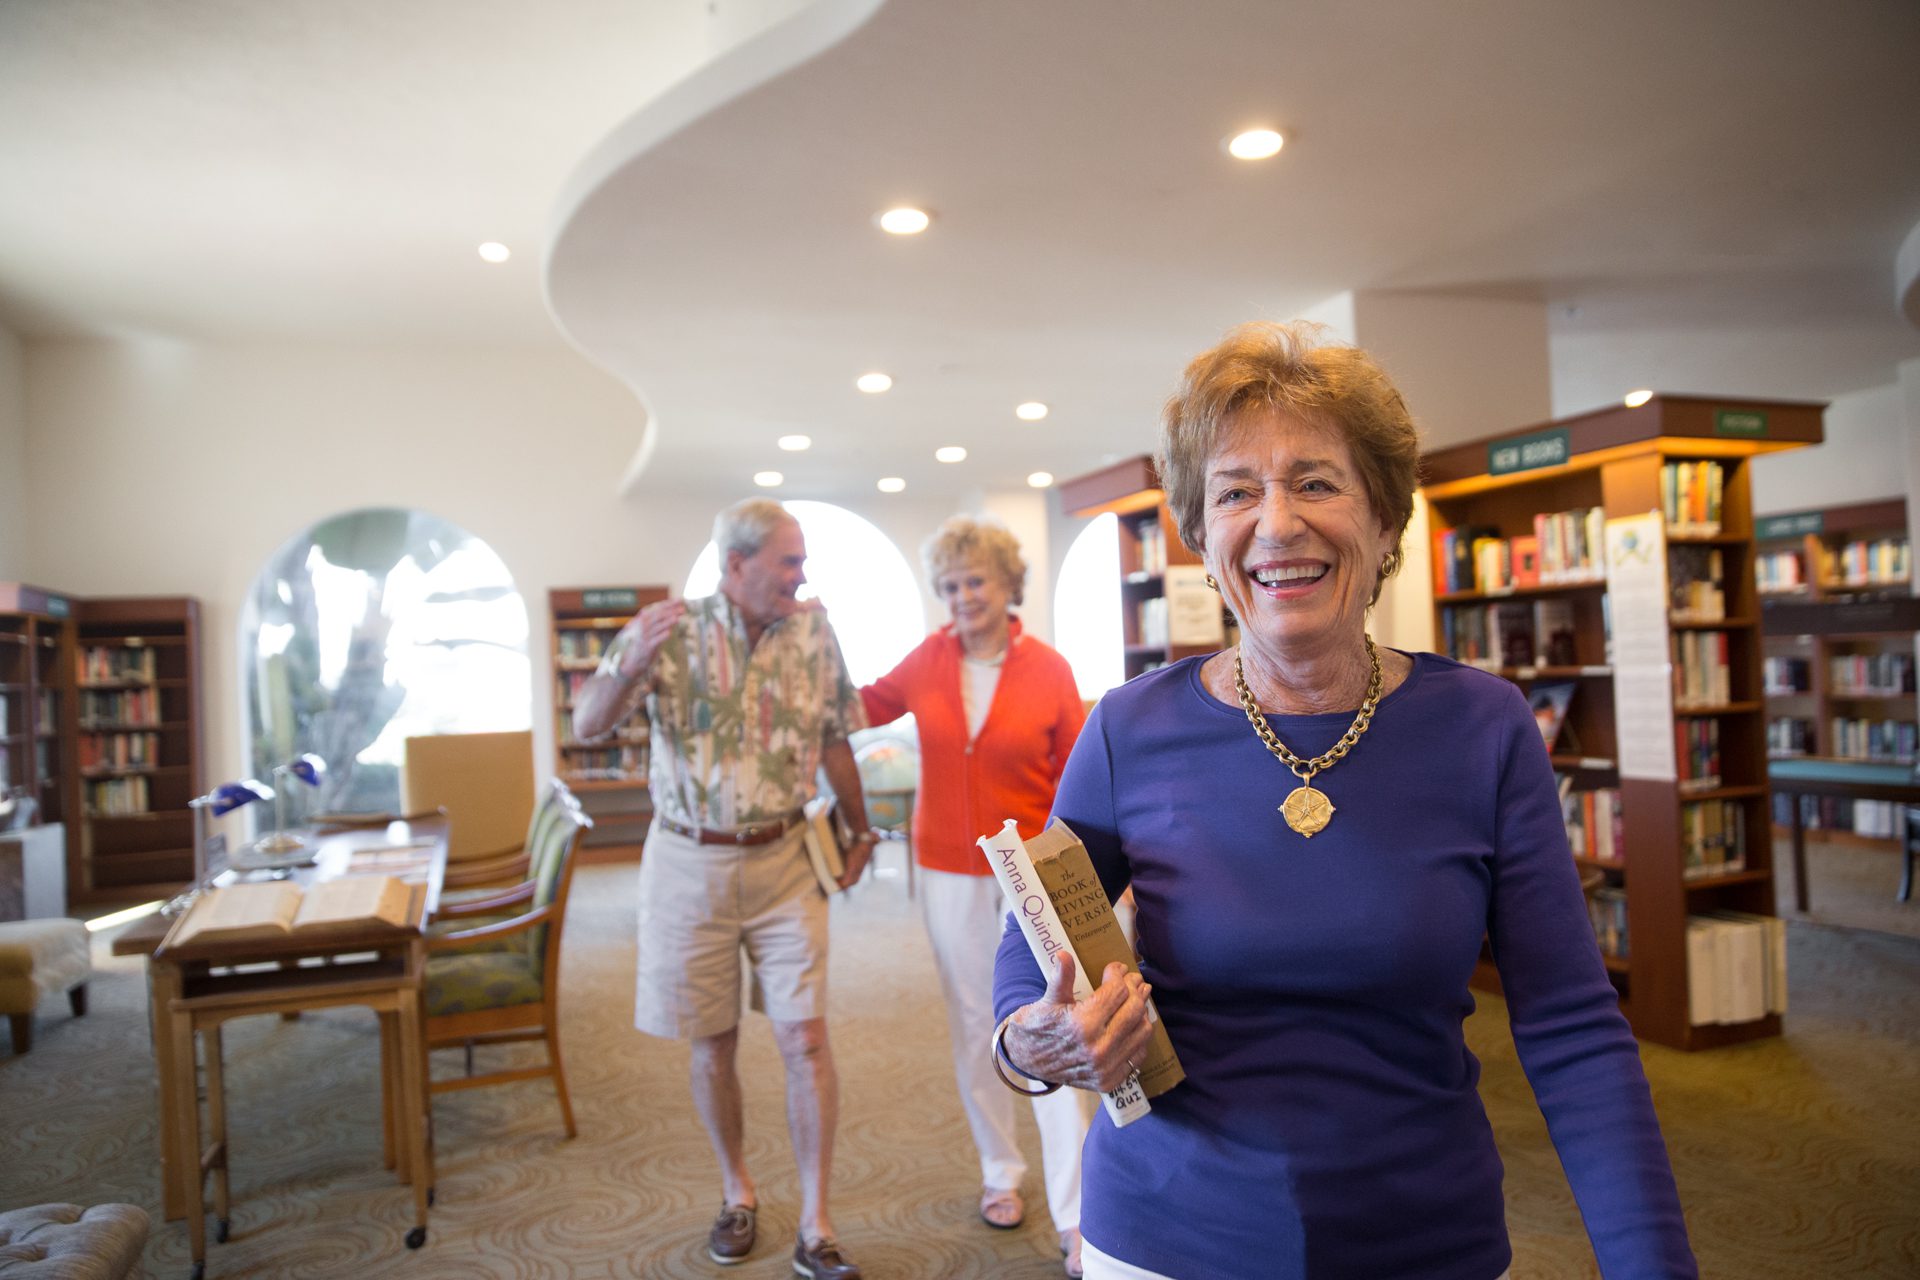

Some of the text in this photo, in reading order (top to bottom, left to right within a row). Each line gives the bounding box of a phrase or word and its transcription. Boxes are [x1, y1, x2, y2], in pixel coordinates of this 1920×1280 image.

[1492, 437, 1565, 469] NEW BOOKS
[997, 849, 1027, 893] Anna
[1060, 870, 1075, 882] The
[1049, 873, 1097, 902] BOOK of
[1055, 888, 1105, 916] LIVING
[1063, 902, 1110, 929] VERSE
[1115, 1090, 1142, 1110] QUI
